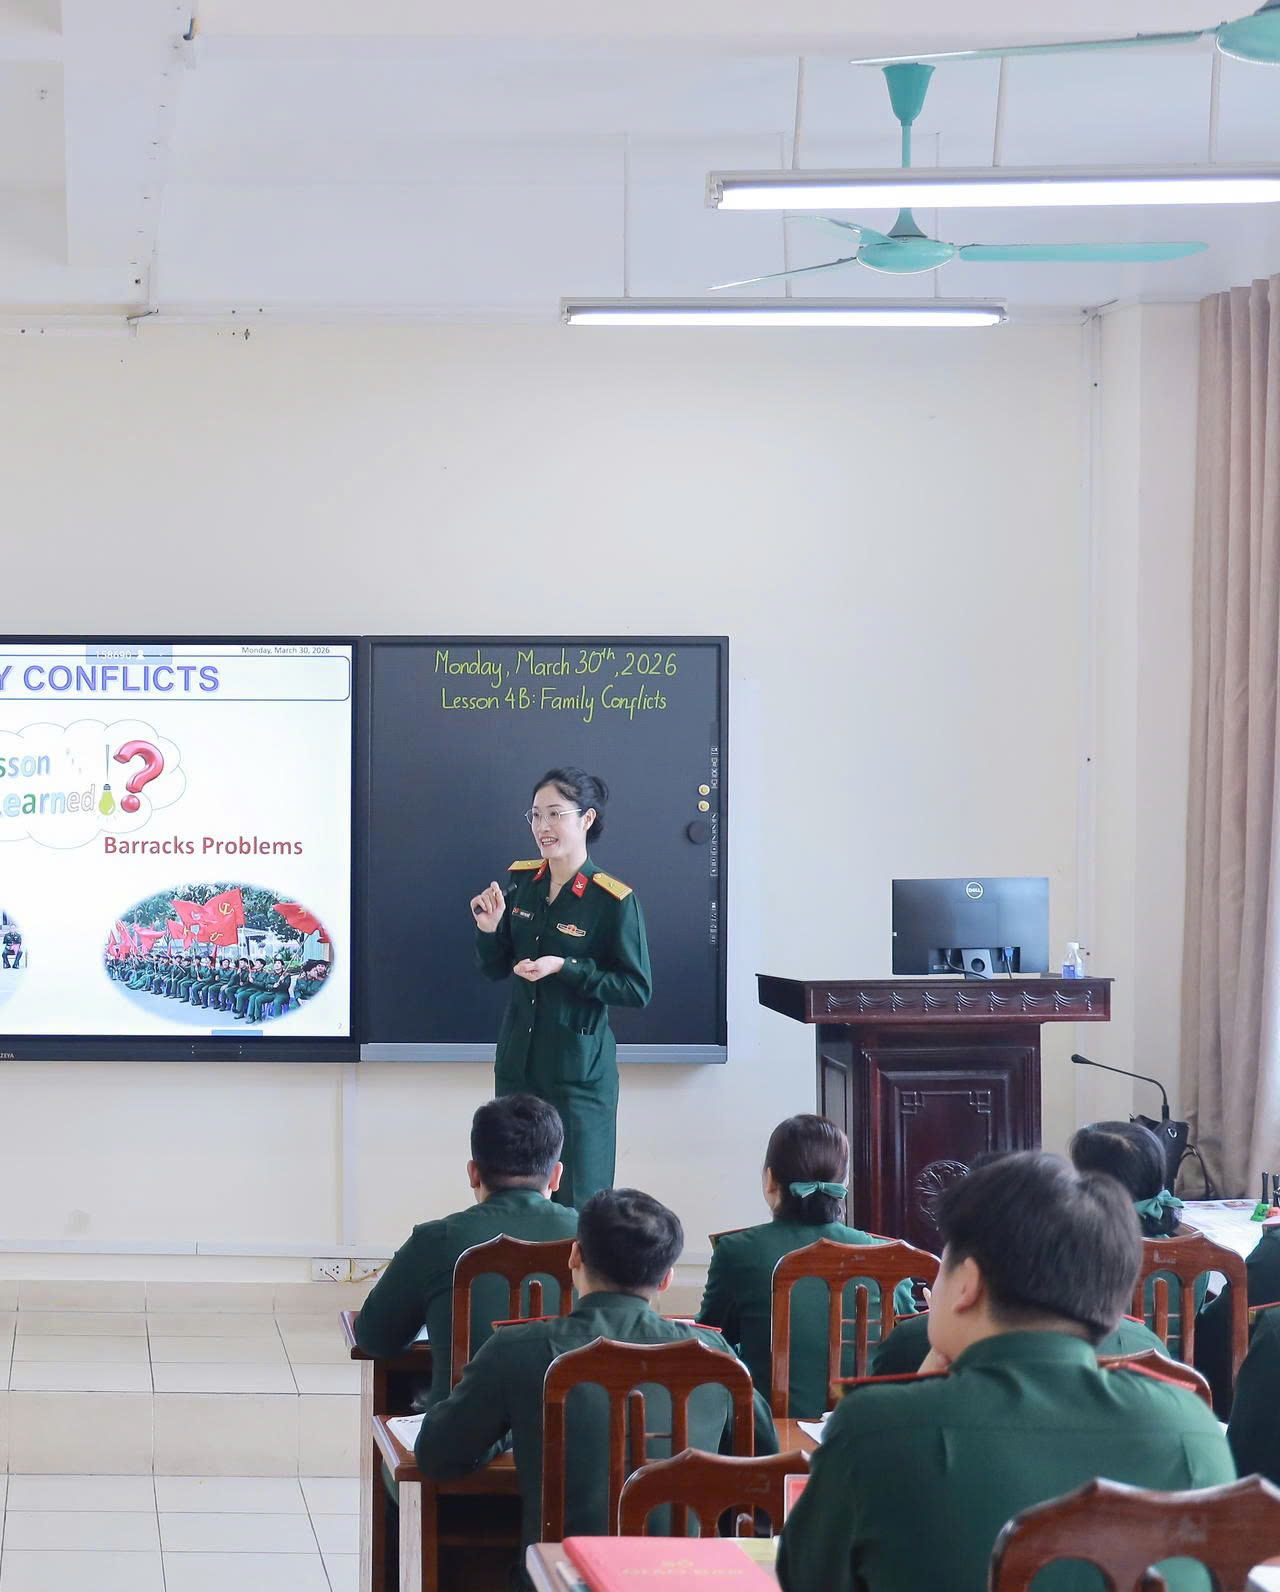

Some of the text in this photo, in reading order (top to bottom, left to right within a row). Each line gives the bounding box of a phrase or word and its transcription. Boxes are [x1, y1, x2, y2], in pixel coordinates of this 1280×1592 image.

[274, 646, 297, 654] March
[312, 646, 331, 654] 2026
[23, 664, 220, 692] CONFLICTS
[434, 649, 510, 688] Monday,
[516, 648, 570, 676] March
[441, 687, 499, 709] Lesson
[540, 684, 595, 723] Family
[601, 684, 667, 720] Conflicts
[104, 835, 303, 855] Barracks Problems
